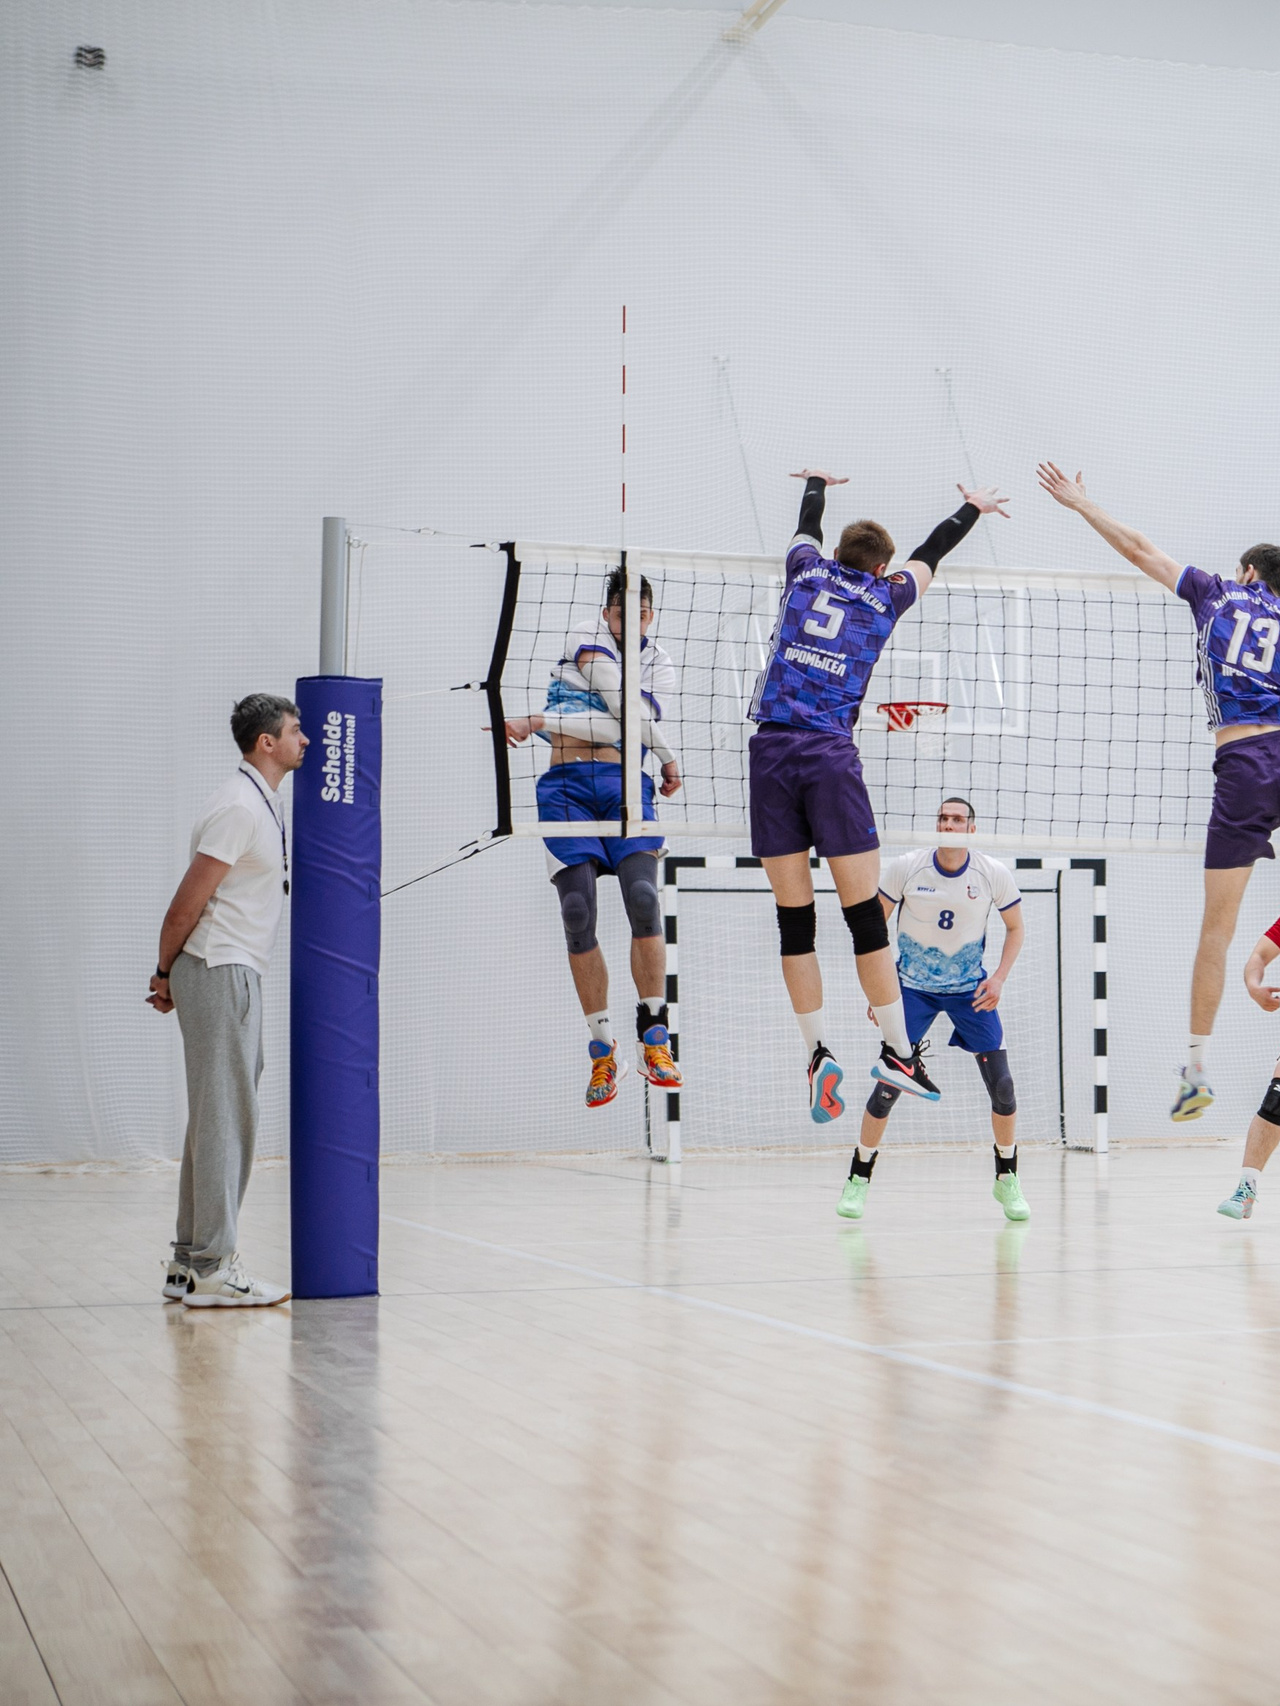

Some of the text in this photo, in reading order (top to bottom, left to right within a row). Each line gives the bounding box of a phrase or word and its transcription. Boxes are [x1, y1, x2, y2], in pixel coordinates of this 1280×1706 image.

[803, 589, 850, 640] 5
[1225, 608, 1280, 674] 13
[784, 646, 847, 677] ПРОМЫСЕЛ
[321, 711, 342, 803] Schelde
[342, 714, 356, 804] International
[937, 909, 955, 930] 8
